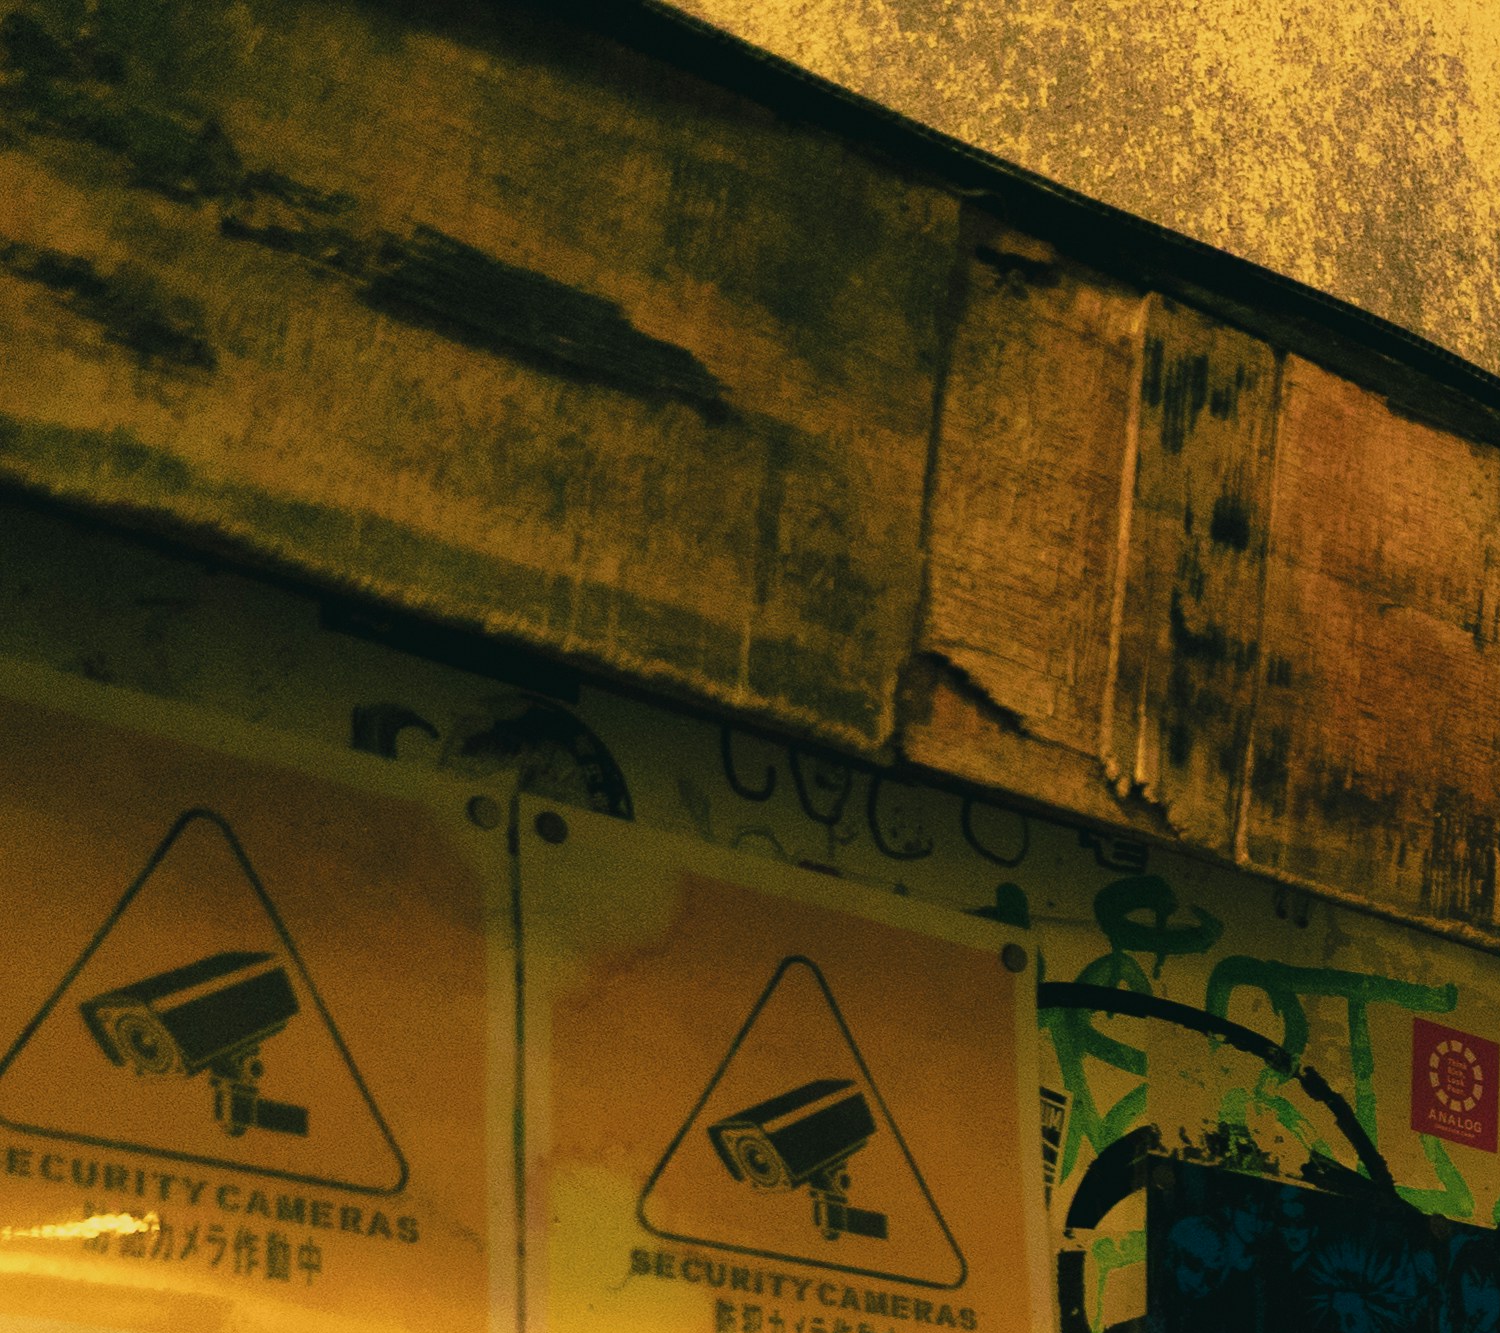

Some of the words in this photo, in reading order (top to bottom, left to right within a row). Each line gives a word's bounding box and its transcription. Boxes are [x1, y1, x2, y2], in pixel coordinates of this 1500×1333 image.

[1427, 1108, 1484, 1135] ANALOG
[216, 1183, 421, 1245] CAMERAS
[629, 1247, 815, 1302] SECURITY
[818, 1281, 979, 1332] CAMERAS
